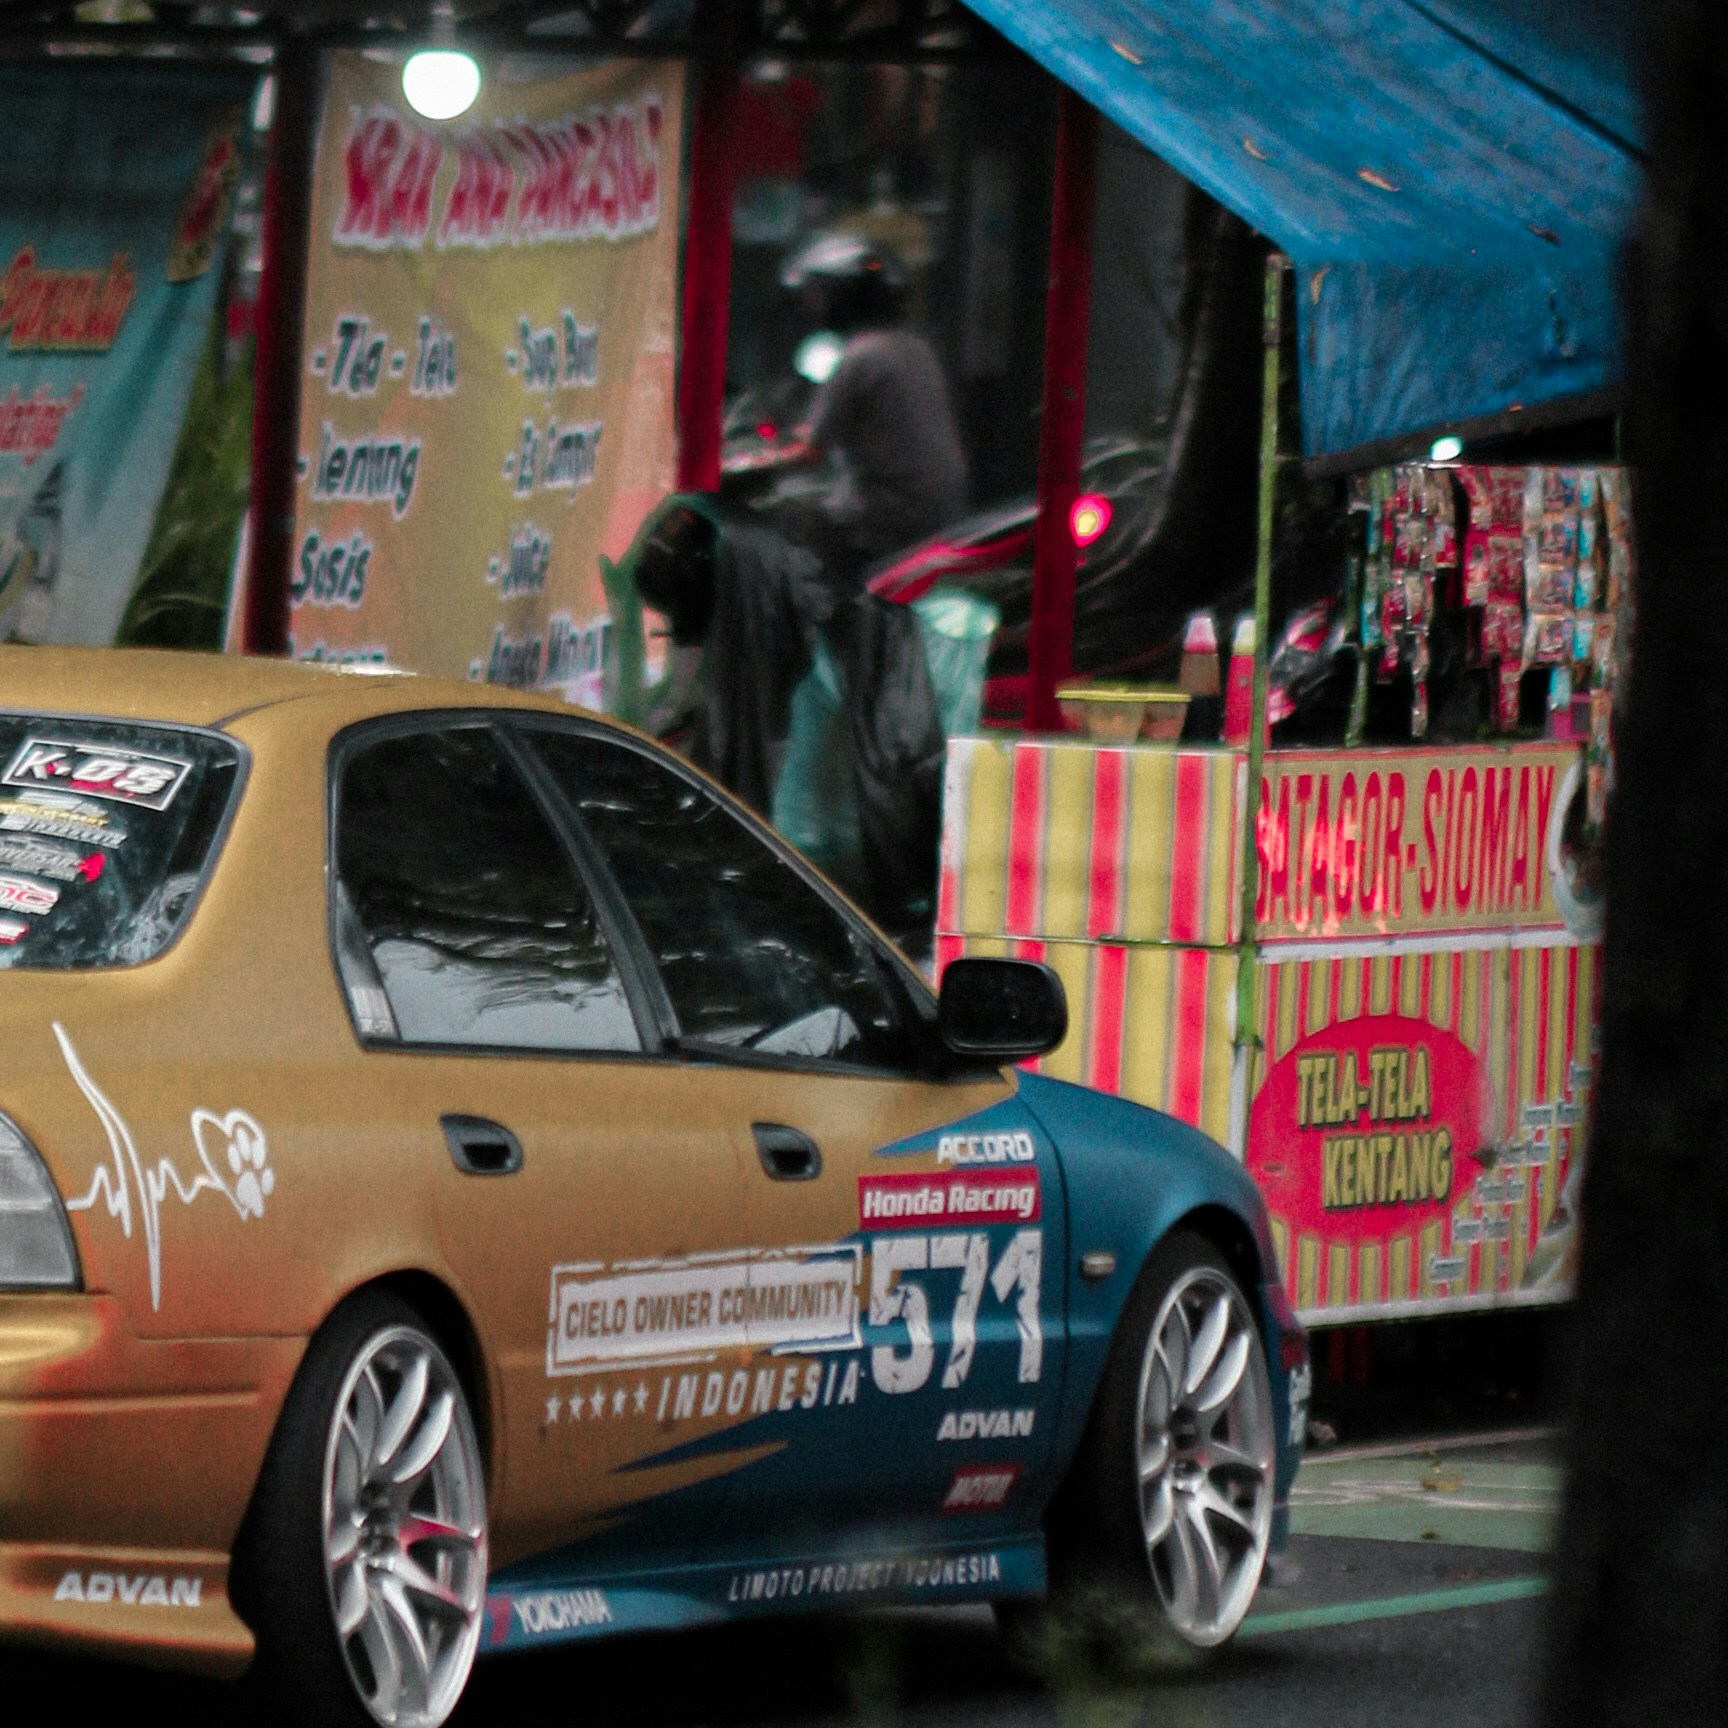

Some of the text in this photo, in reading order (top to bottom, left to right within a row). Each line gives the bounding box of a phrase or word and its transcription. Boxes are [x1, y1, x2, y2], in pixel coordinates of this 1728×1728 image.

[1298, 1046, 1430, 1130] TELA-TELA
[937, 1133, 1034, 1164] ACCORD
[1324, 1129, 1453, 1212] KENTANG
[863, 1184, 1035, 1218] Honda Racing
[565, 1280, 847, 1339] CIELO OWNER COMMUNITY
[869, 1228, 1042, 1394] 571
[657, 1360, 860, 1421] INDONESIA
[936, 1410, 1034, 1440] ADVAN
[54, 1571, 202, 1607] ADVAN
